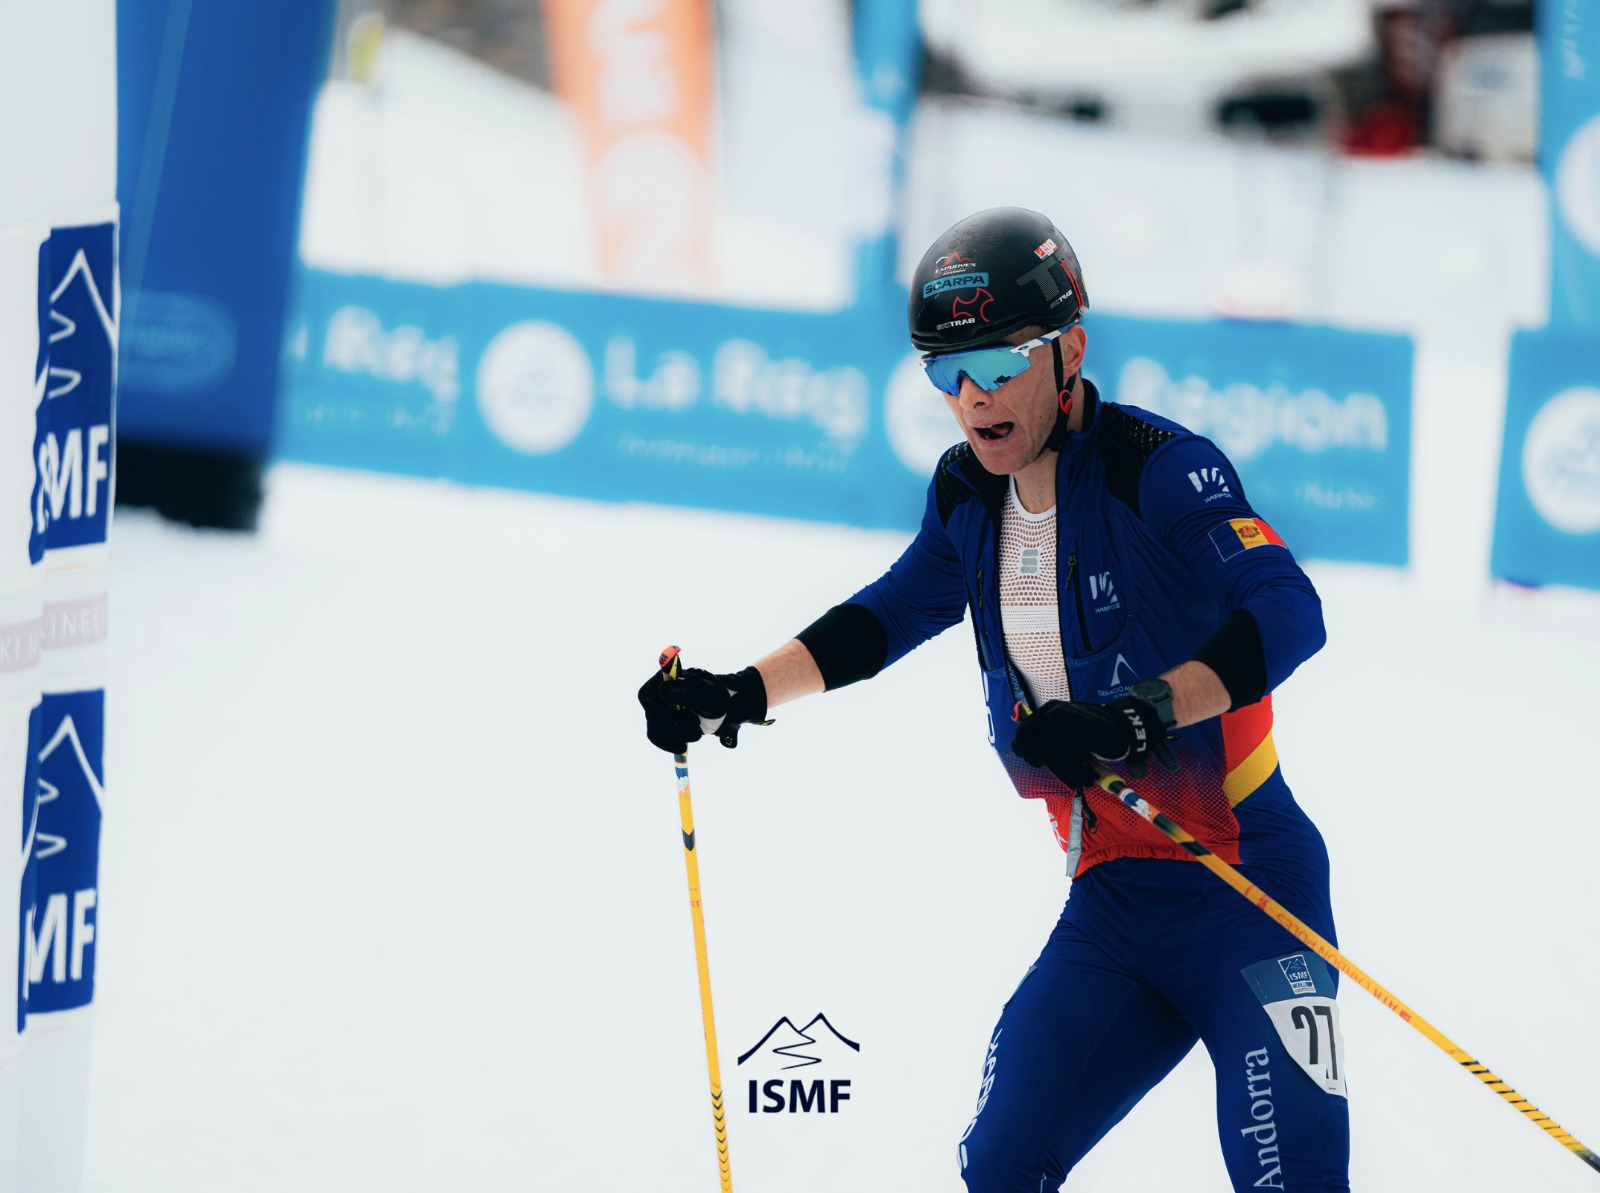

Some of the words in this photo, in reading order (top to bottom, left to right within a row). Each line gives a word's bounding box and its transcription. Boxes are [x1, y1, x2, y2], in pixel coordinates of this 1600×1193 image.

[925, 275, 985, 294] SCARPA
[1123, 708, 1147, 752] LEKI
[1240, 1046, 1285, 1192] Andorra
